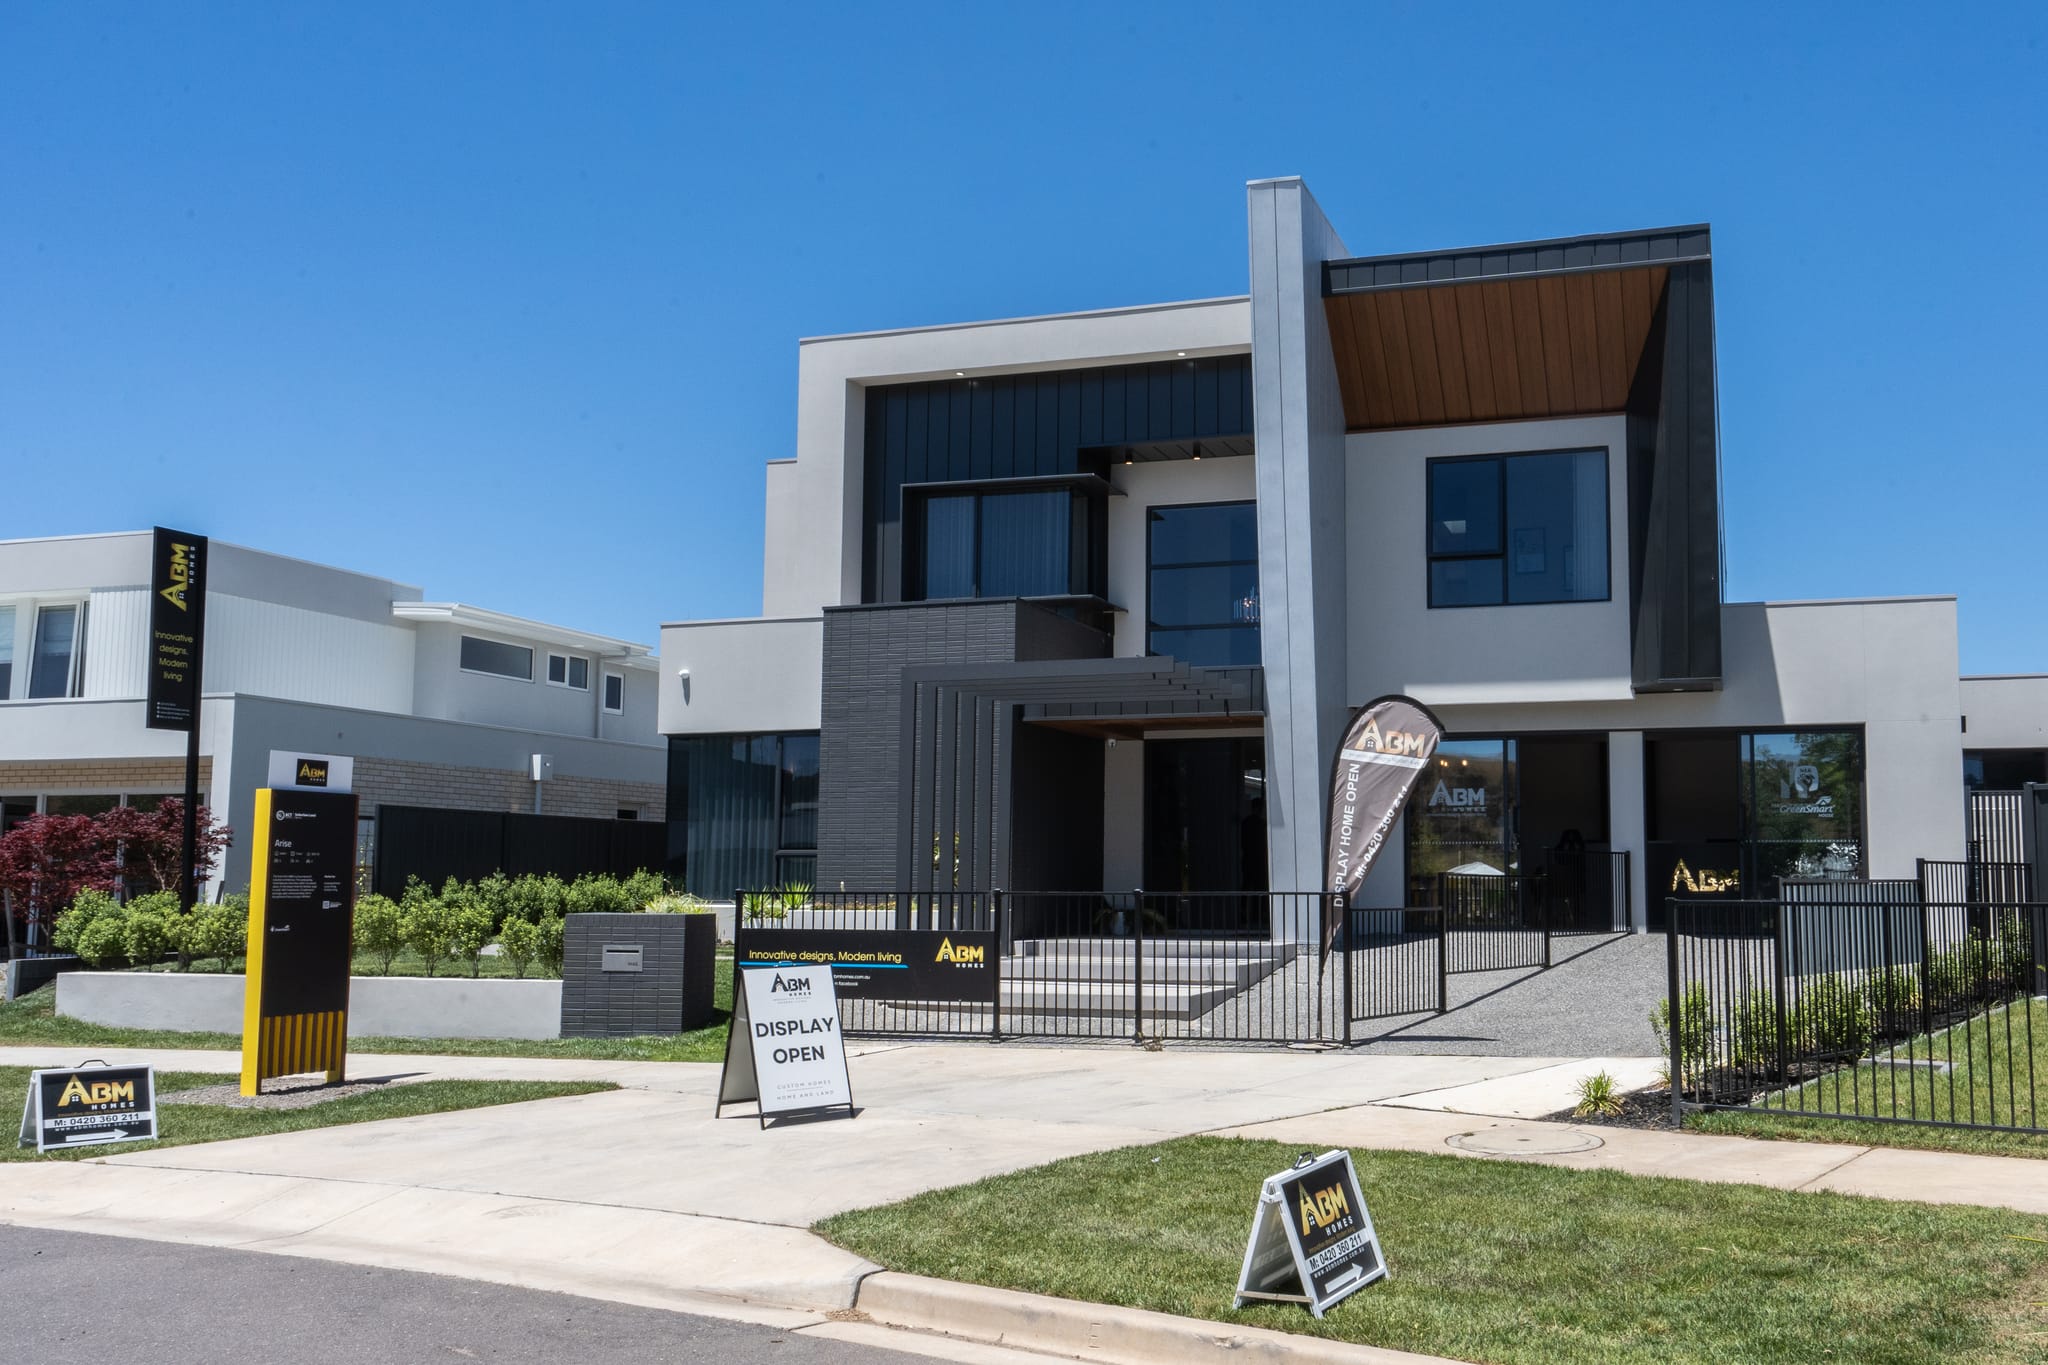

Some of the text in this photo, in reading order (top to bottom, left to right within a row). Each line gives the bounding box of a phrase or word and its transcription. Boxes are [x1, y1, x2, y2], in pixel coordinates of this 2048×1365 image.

[160, 543, 189, 611] ABM
[155, 630, 193, 642] Innovative
[159, 658, 188, 668] Modern
[163, 671, 183, 682] living
[1355, 718, 1425, 757] ABM
[299, 763, 325, 778] ABM
[1346, 763, 1361, 803] OPEN
[1428, 779, 1485, 806] ABM
[1340, 805, 1355, 847] HOME
[274, 839, 292, 848] Arise
[1364, 833, 1383, 864] 0420
[749, 950, 797, 960] Innovative
[839, 952, 876, 961] Modern
[877, 952, 902, 963] living
[935, 937, 984, 962] ABM
[771, 973, 811, 992] ABM
[755, 1017, 833, 1038] DISPLAY
[772, 1045, 825, 1064] OPEN
[57, 1074, 134, 1107] ABM
[91, 1101, 135, 1110] HOMES
[54, 1119, 67, 1127] M:
[70, 1116, 96, 1125] 0420
[99, 1114, 119, 1123] 360
[121, 1112, 139, 1121] 211
[1299, 1180, 1350, 1236] ABM
[1325, 1216, 1354, 1237] HOMES
[1309, 1257, 1320, 1271] M:
[1319, 1248, 1337, 1265] 0420
[1337, 1240, 1350, 1255] 360
[1350, 1233, 1362, 1248] 211
